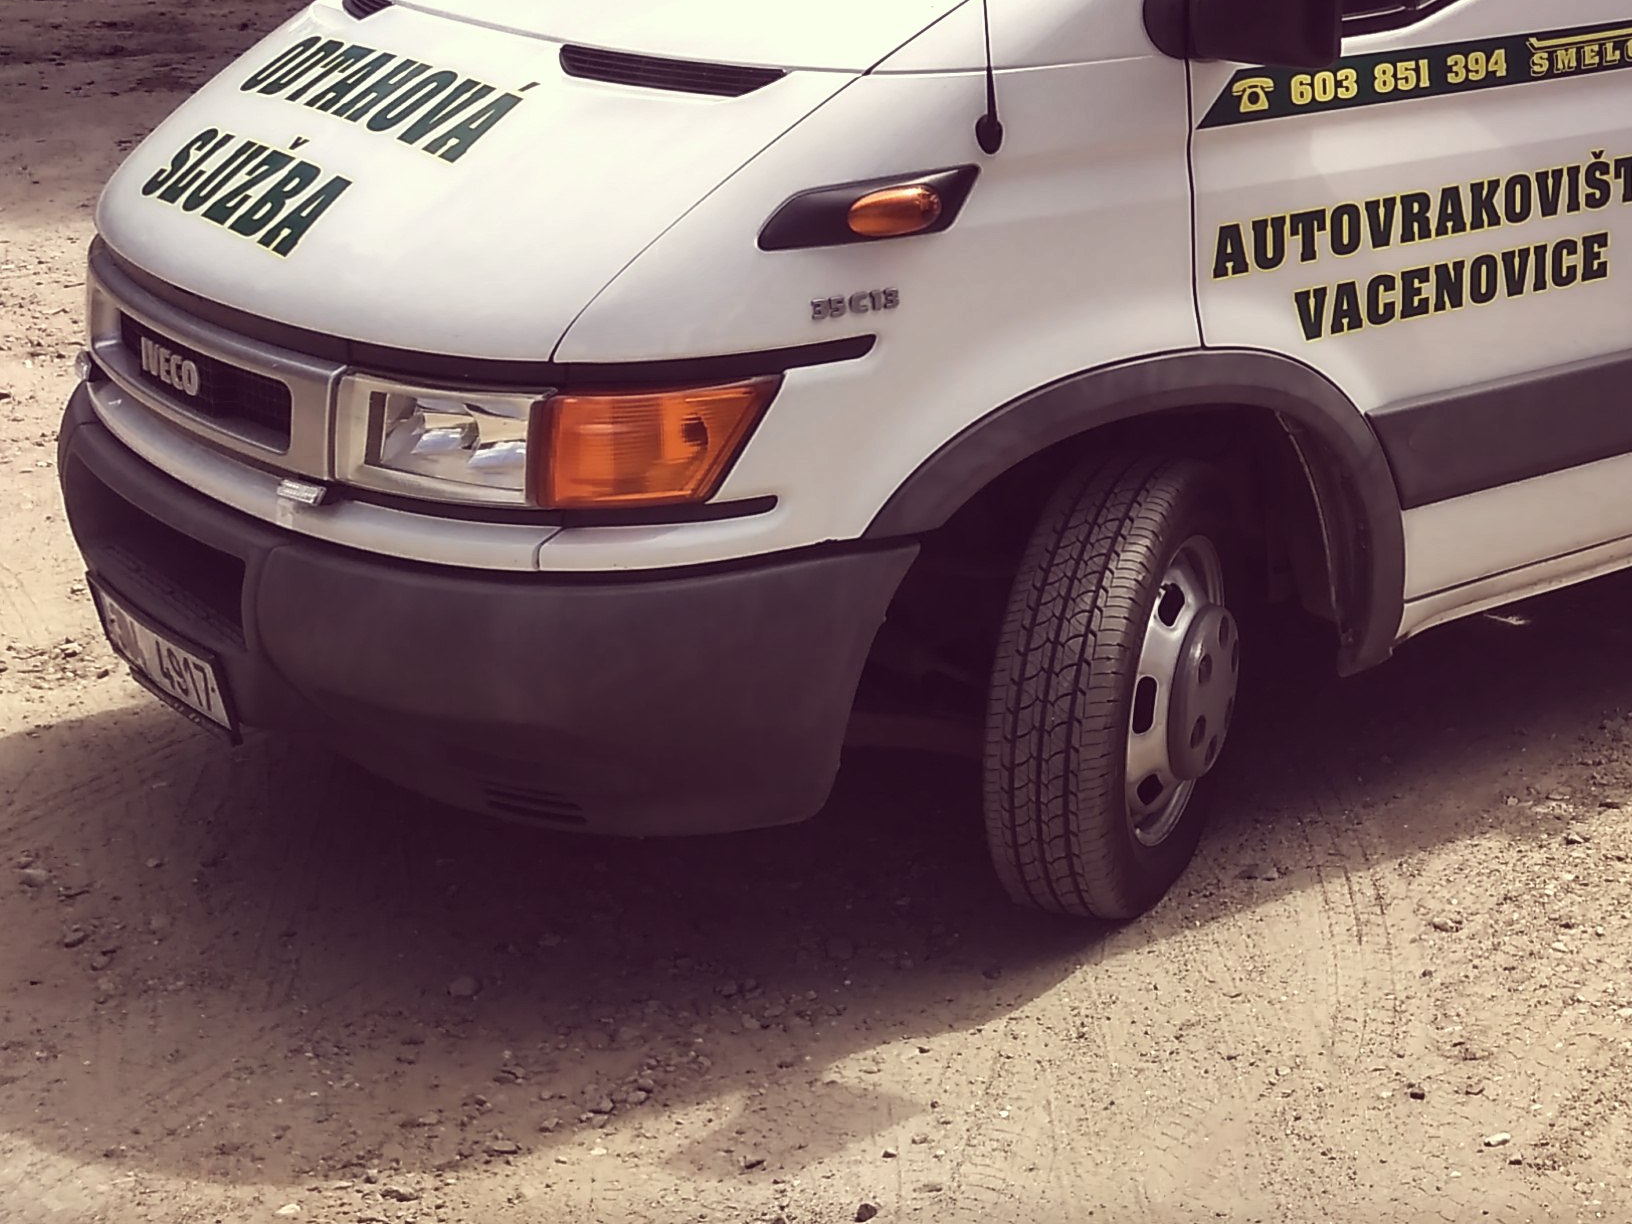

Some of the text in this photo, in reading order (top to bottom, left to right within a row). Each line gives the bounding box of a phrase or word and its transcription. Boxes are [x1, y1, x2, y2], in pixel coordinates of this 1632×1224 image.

[239, 35, 541, 164] ODTAHOVÁ
[1290, 68, 1358, 106] 603
[1373, 58, 1431, 95] 851
[1446, 48, 1508, 84] 394
[141, 127, 353, 259] SLUŽBA
[1293, 231, 1610, 342] VACENOVICE
[140, 336, 199, 396] IVECO
